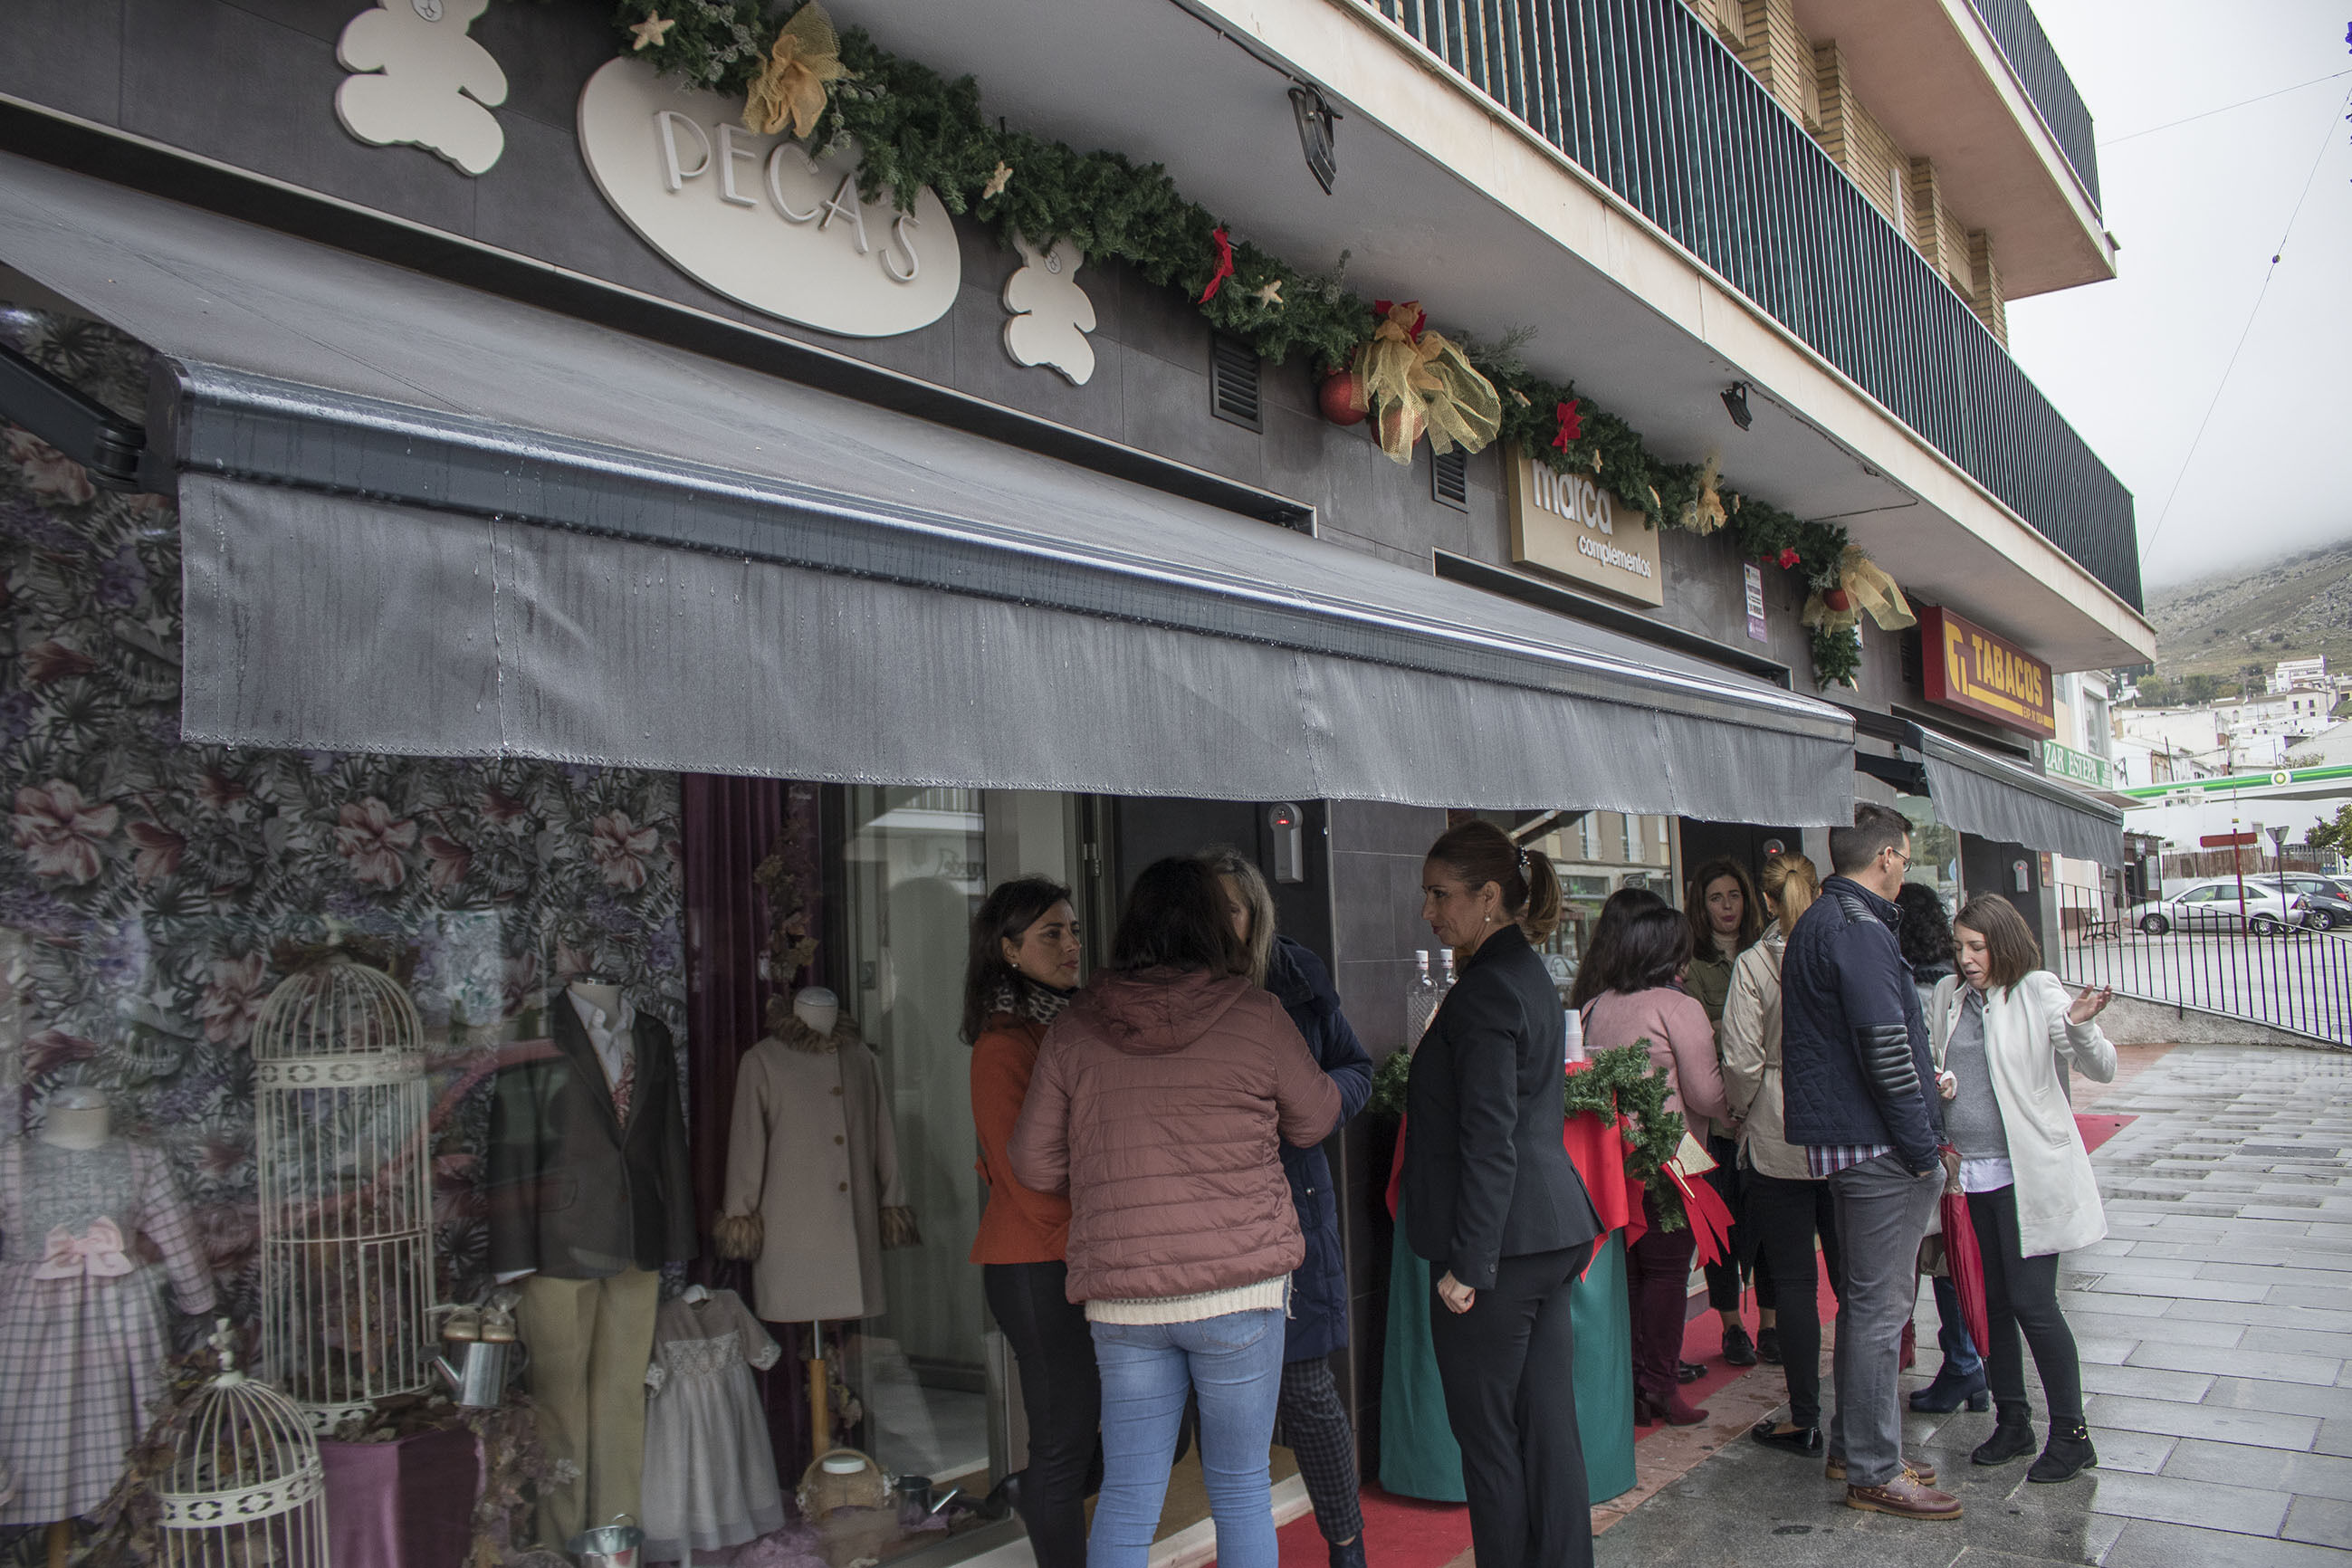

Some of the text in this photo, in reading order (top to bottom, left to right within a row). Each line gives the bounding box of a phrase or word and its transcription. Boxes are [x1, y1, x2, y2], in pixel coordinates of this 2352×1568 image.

[1532, 458, 1613, 536] marca
[1578, 535, 1651, 578] complementos
[1972, 634, 2043, 708] TABACOS
[2068, 751, 2099, 784] ESTEPA
